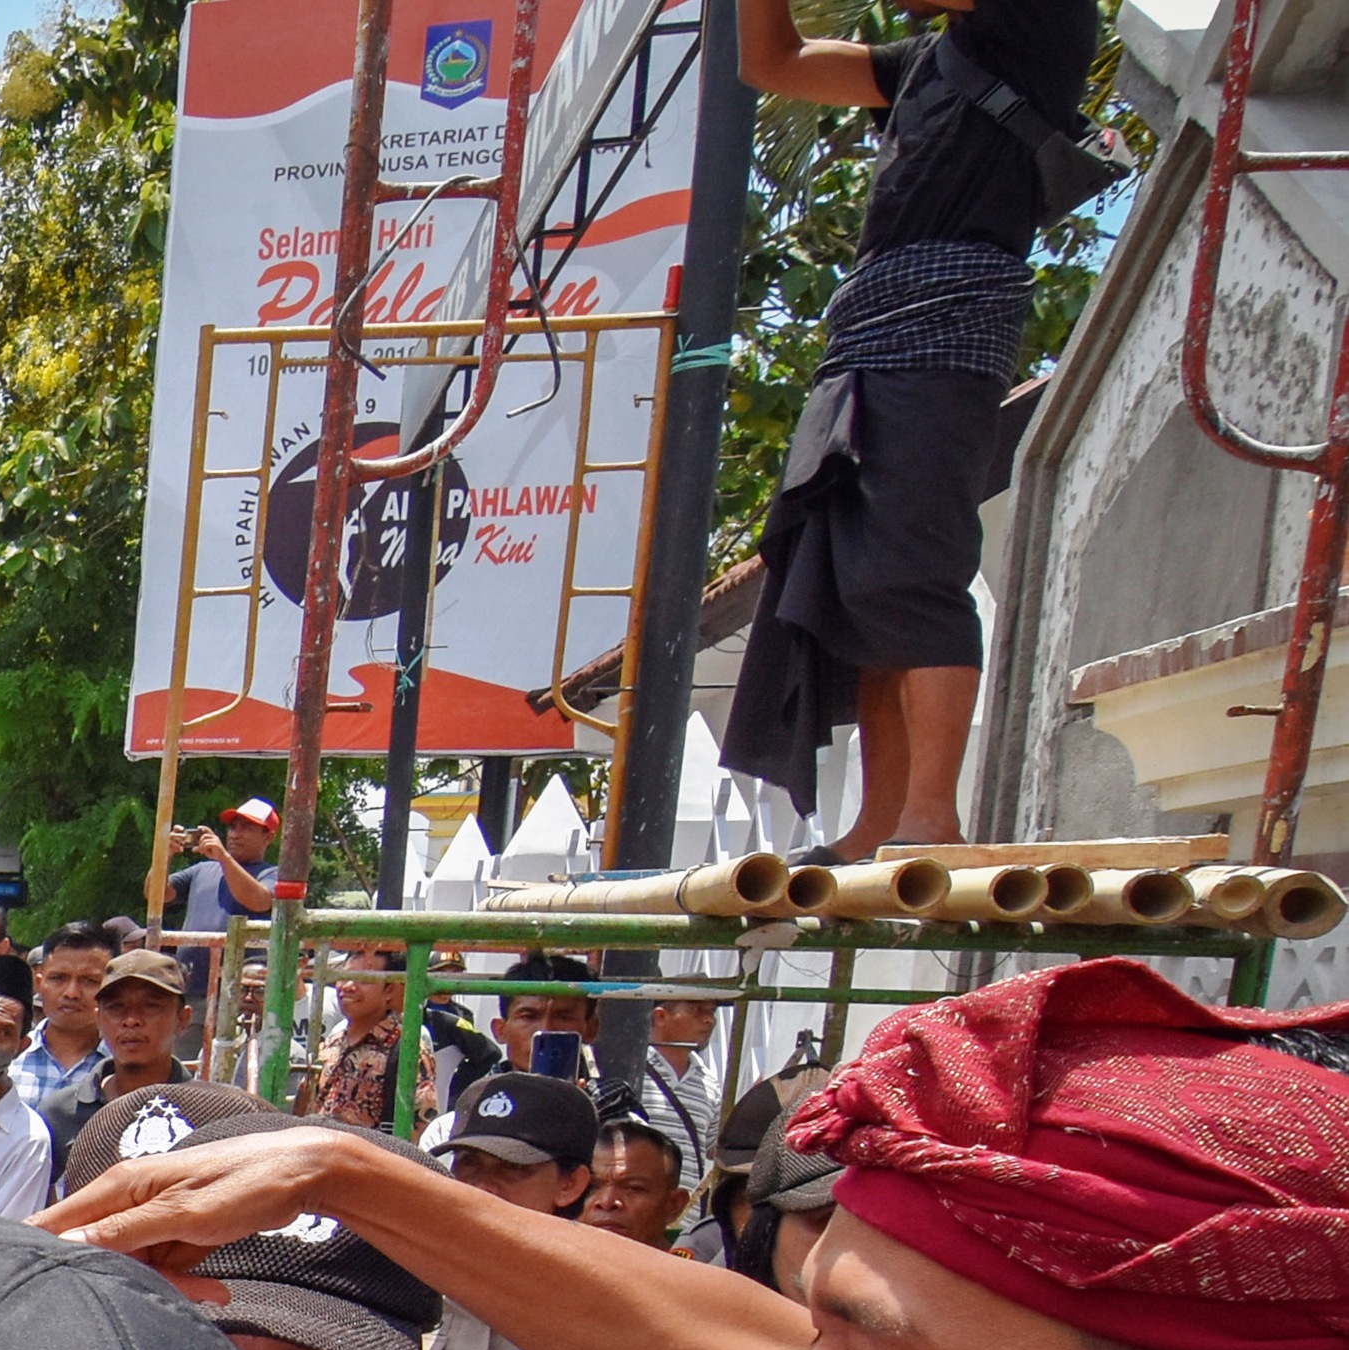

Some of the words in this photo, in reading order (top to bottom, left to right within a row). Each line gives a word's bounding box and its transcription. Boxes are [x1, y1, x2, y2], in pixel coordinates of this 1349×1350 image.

[379, 126, 489, 149] KRETARIAT
[273, 163, 346, 182] PROVIN
[435, 147, 504, 169] TENGG
[258, 226, 342, 261] Selam
[376, 215, 435, 252] Hari
[247, 354, 269, 377] 10
[446, 484, 598, 519] PAHLAWAN
[474, 523, 538, 566] Kini
